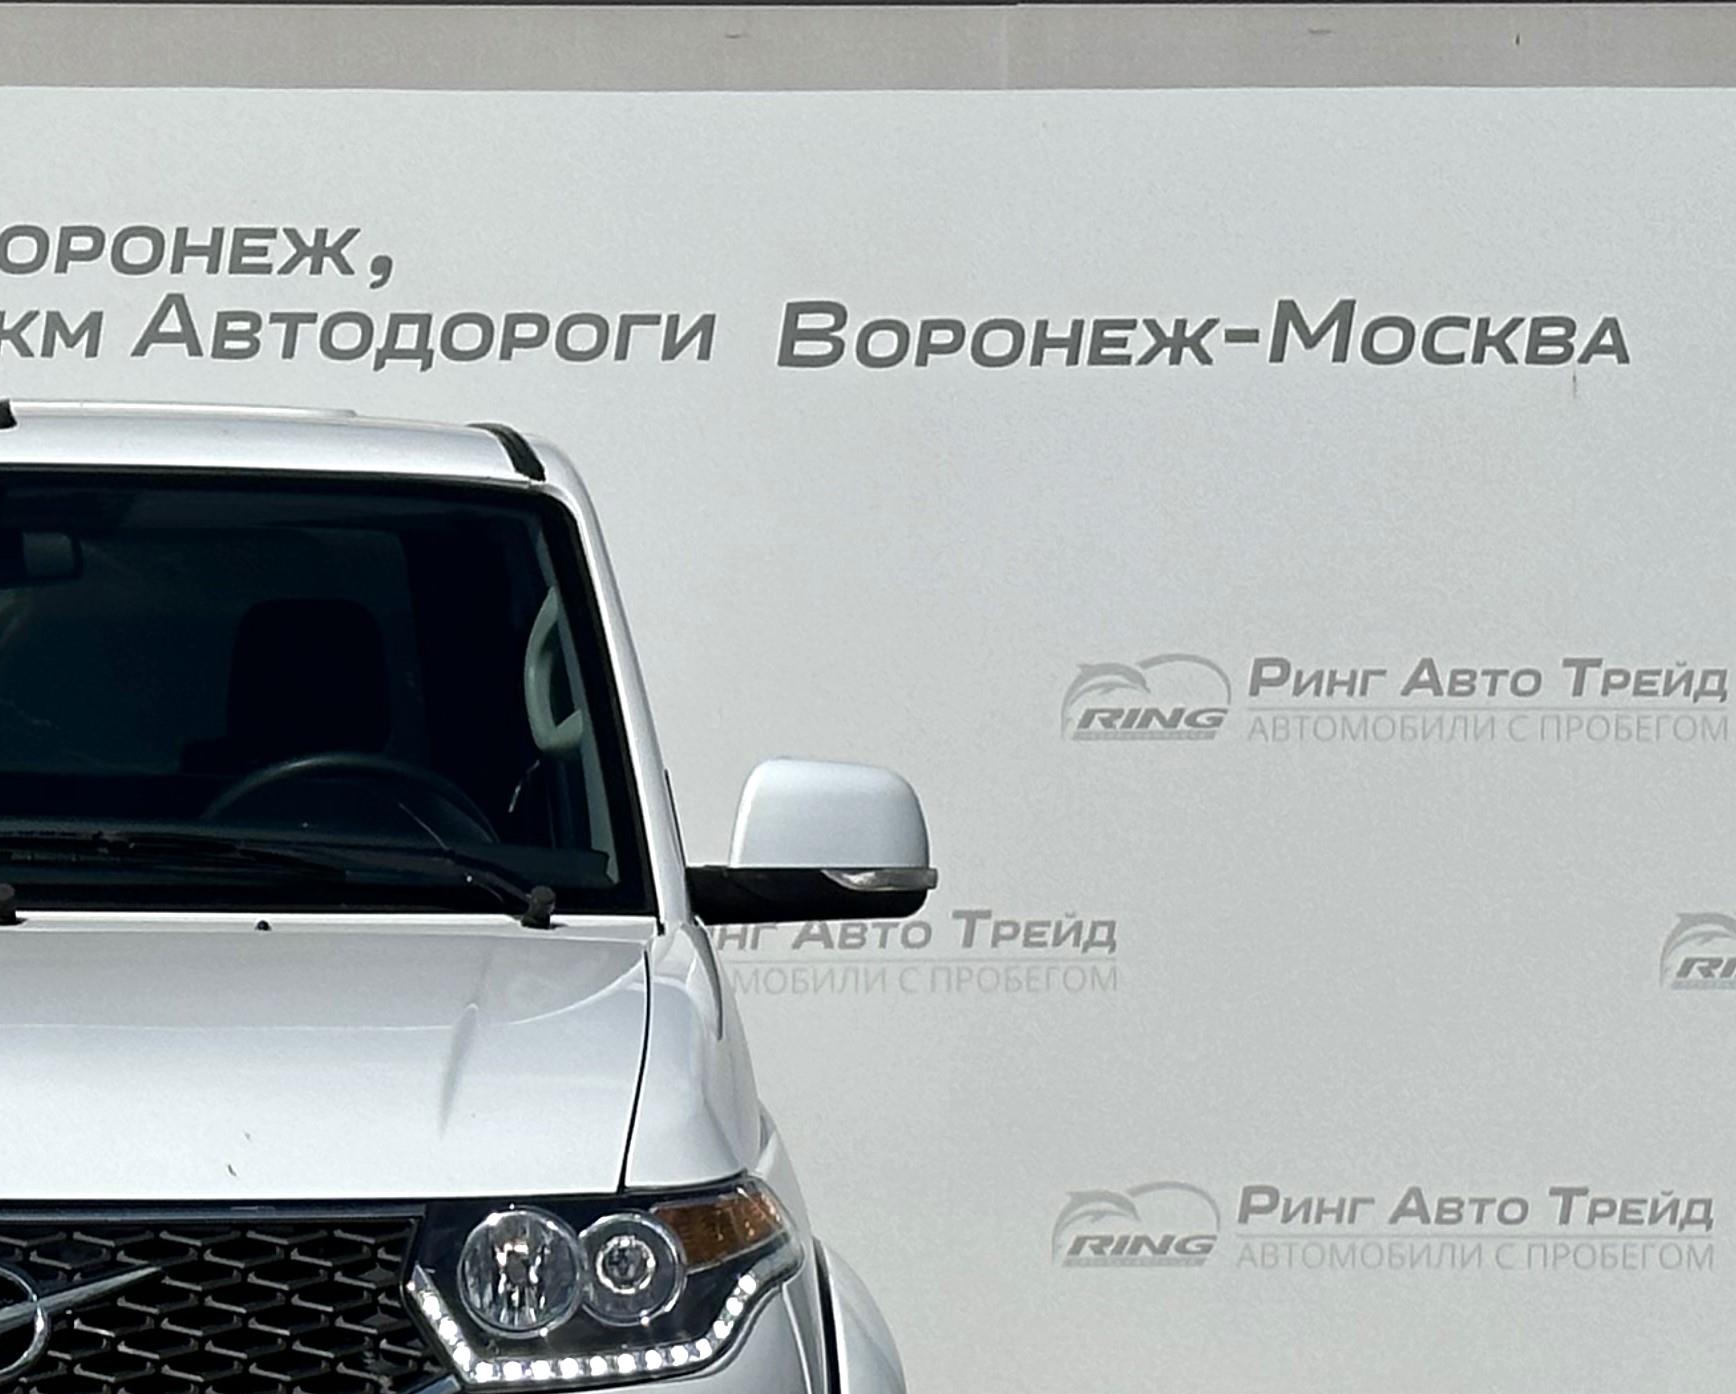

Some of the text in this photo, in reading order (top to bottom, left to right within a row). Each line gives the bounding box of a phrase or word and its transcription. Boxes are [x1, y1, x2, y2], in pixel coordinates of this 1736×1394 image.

[128, 291, 716, 372] Автодороги
[1399, 657, 1543, 698] Авто
[1563, 657, 1729, 704] Трейд
[1076, 707, 1229, 729] RING
[1249, 713, 1729, 743] АВТОМОБИЛИ С ПРОБЕГОМ
[952, 909, 1116, 954] Трейд
[899, 967, 918, 994] С
[930, 967, 1117, 993] ПРОБЕГОМ
[1390, 1185, 1528, 1226] Авто
[1549, 1187, 1713, 1232] Трейд
[1069, 1235, 1216, 1255] RING
[1237, 1241, 1714, 1271] АВТОМОБИЛИ С ПРОБЕГОМ
